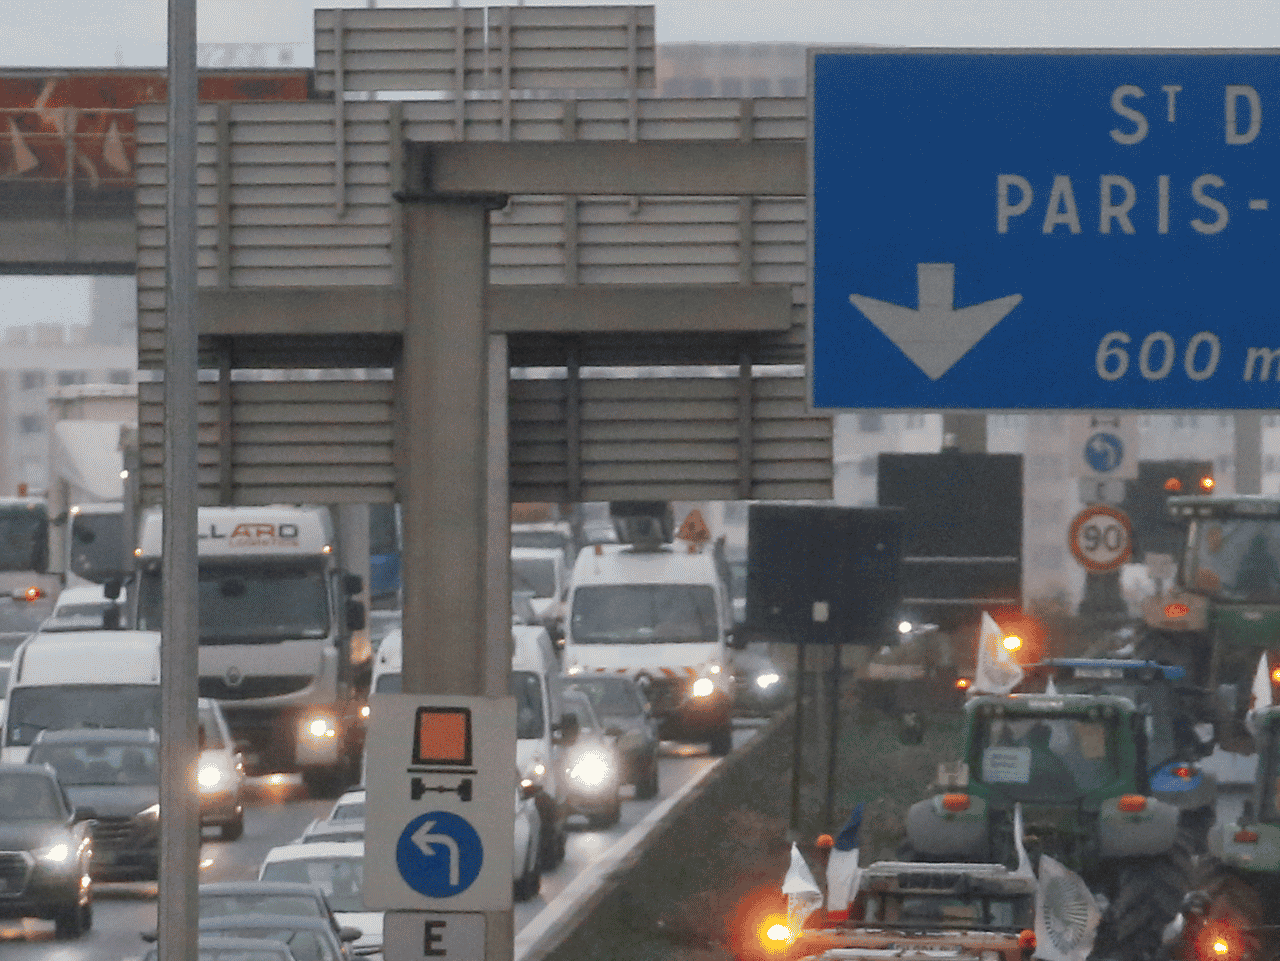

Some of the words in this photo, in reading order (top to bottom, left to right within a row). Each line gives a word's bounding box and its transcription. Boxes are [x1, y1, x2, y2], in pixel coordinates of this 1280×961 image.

[1110, 84, 1182, 146] ST
[1095, 330, 1222, 381] 600
[198, 522, 300, 539] LARD
[1082, 523, 1123, 552] 90
[424, 920, 447, 957] E
